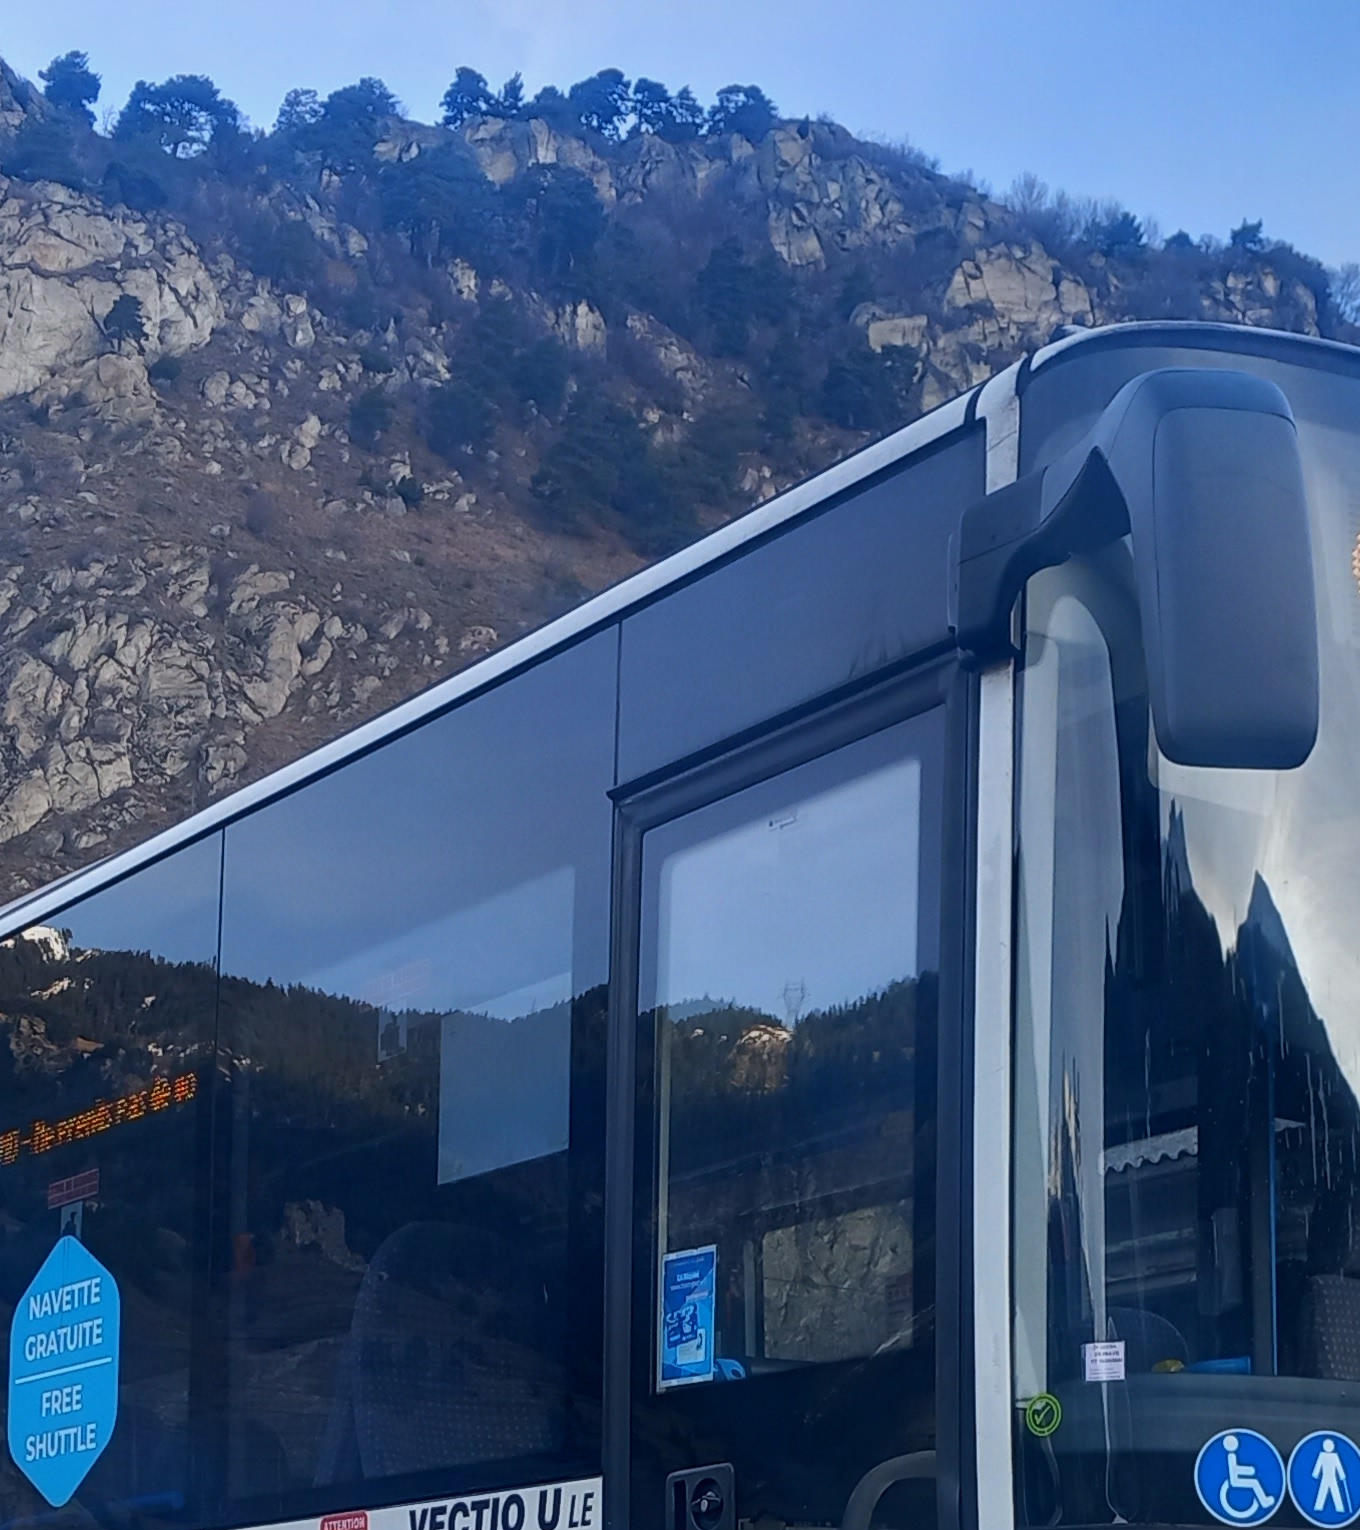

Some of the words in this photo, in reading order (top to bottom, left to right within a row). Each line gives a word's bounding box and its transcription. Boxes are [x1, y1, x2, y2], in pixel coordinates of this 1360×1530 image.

[29, 1277, 101, 1321] NAVETTE
[25, 1319, 103, 1363] GRATUITE
[42, 1384, 82, 1418] FREE
[25, 1423, 96, 1463] SHUTTLE
[568, 1492, 595, 1528] LE
